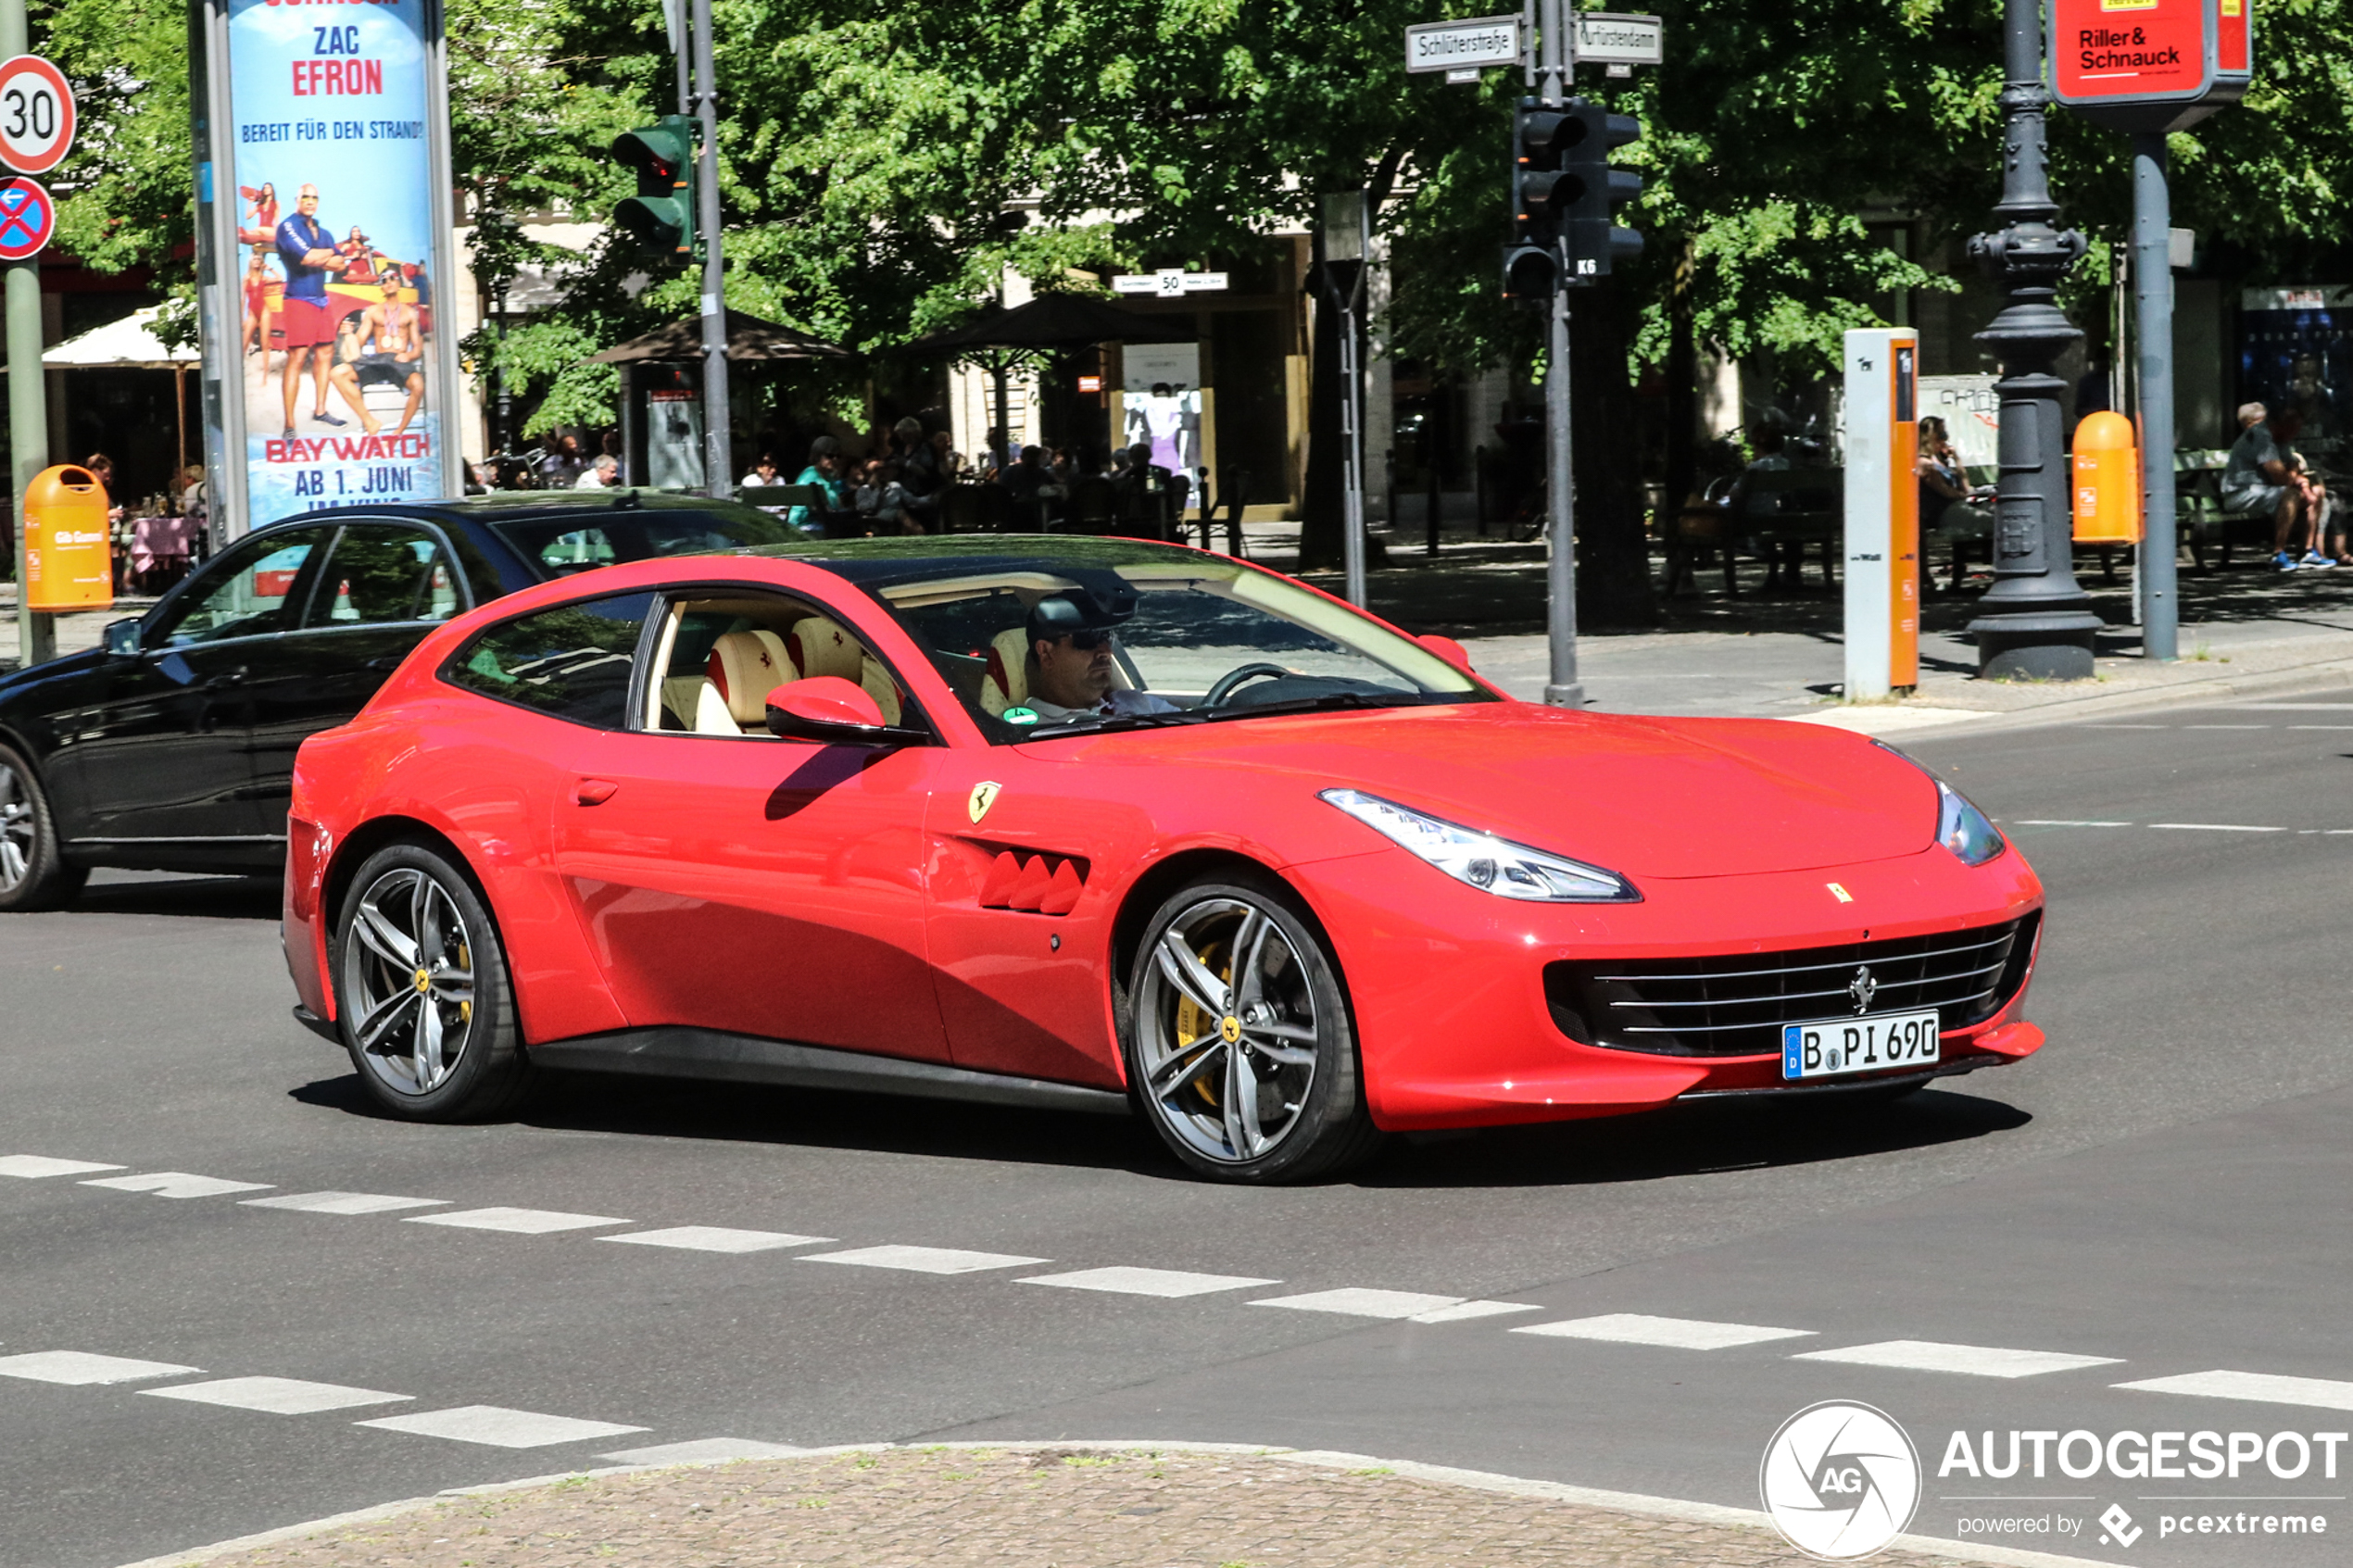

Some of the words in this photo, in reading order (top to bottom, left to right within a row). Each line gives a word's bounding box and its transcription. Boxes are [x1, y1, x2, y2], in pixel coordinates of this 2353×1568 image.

[313, 26, 359, 55] ZAC
[1419, 30, 1509, 56] Schlüterstraße
[2080, 30, 2130, 48] Riller
[2132, 27, 2146, 45] &
[2081, 47, 2180, 69] Schnauck
[292, 59, 383, 95] EFRON
[5, 89, 53, 139] 30
[242, 123, 290, 143] BEREIT
[296, 119, 326, 140] FÜR
[333, 121, 363, 140] DEN
[1578, 259, 1596, 274] K6
[1163, 277, 1178, 289] 50
[266, 434, 431, 463] BAYWATCH
[295, 470, 324, 496] AB
[335, 470, 353, 495] 1.
[362, 467, 412, 493] JUNI
[1805, 1032, 1821, 1070] B
[1843, 1026, 1878, 1065] PI
[1886, 1019, 1936, 1060] 690
[1790, 1057, 1797, 1069] D
